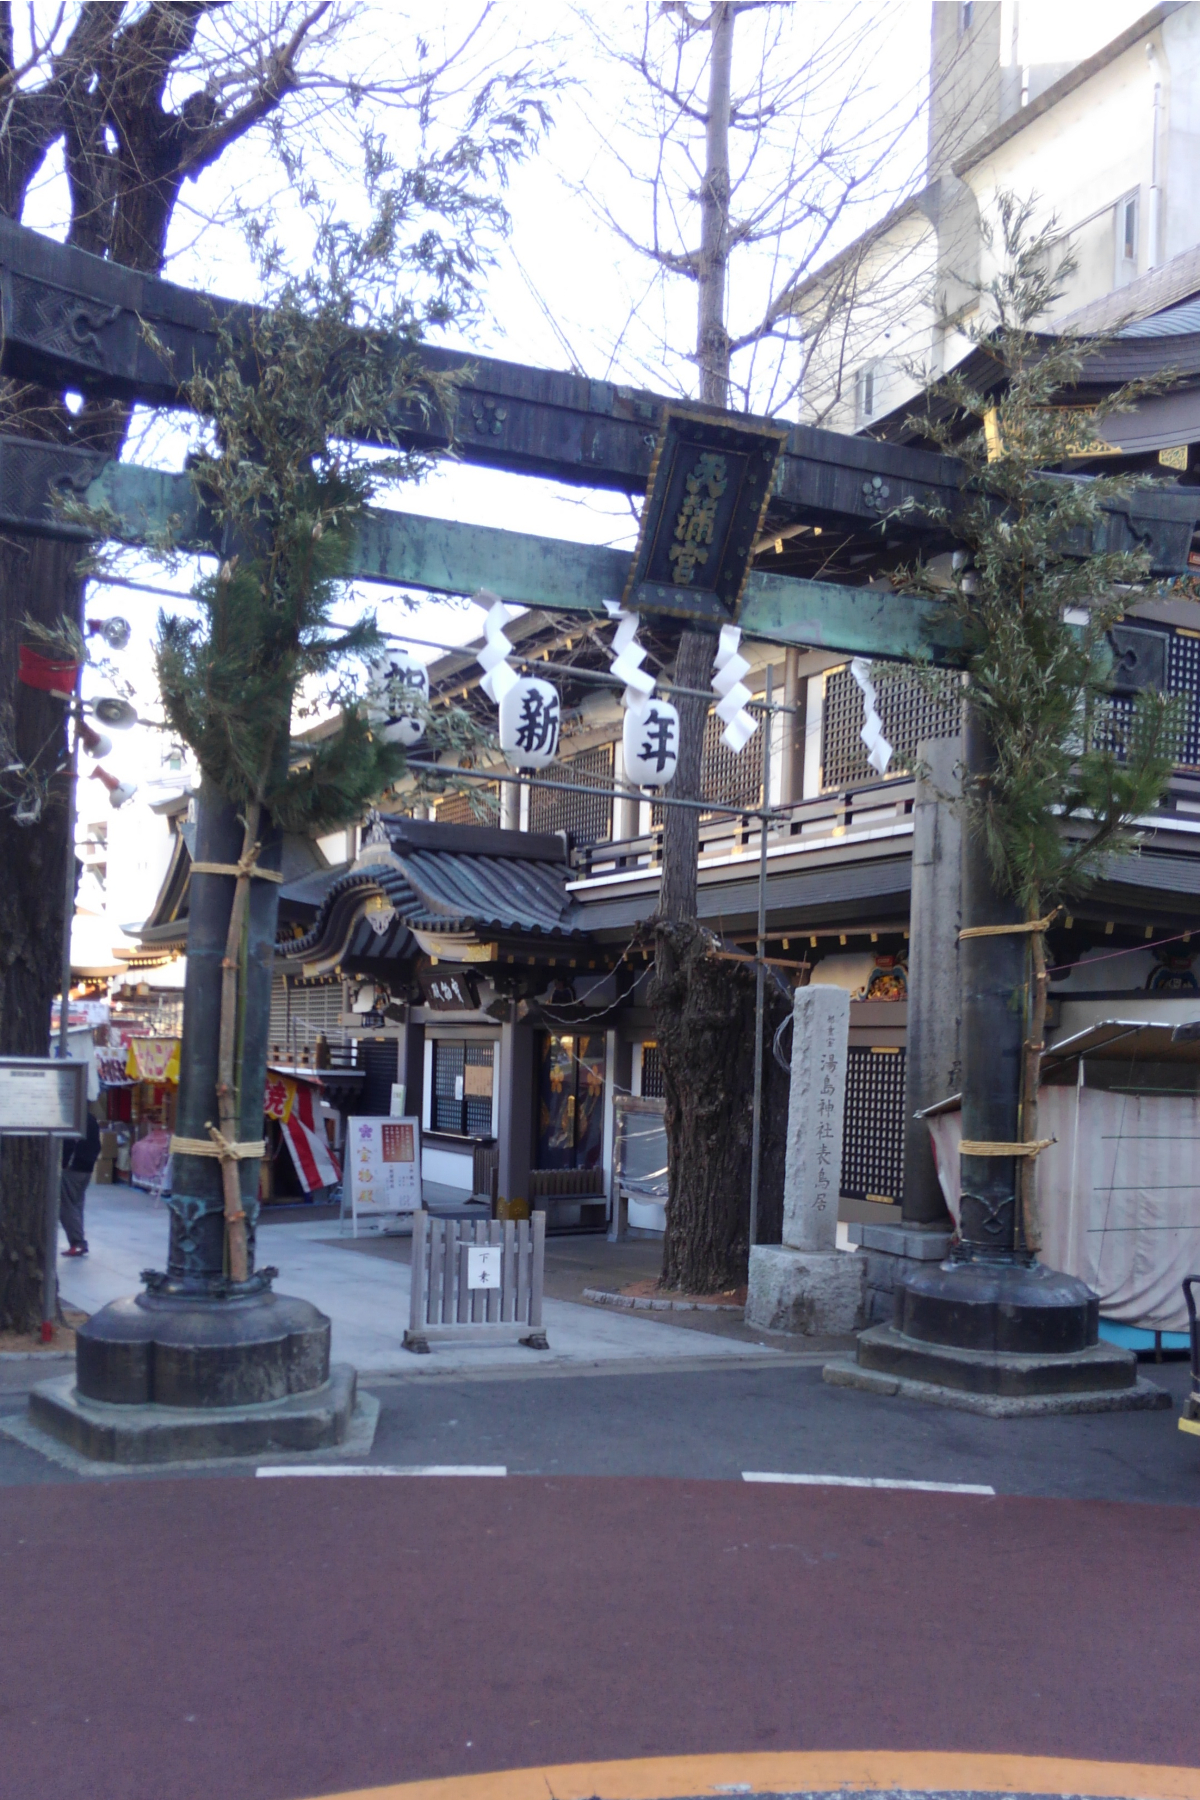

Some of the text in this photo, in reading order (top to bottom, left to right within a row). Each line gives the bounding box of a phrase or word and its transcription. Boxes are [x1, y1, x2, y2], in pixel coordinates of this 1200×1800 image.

[515, 687, 560, 756] 新
[636, 708, 677, 773] 年
[811, 1053, 839, 1212] 湯島神社表鳥居
